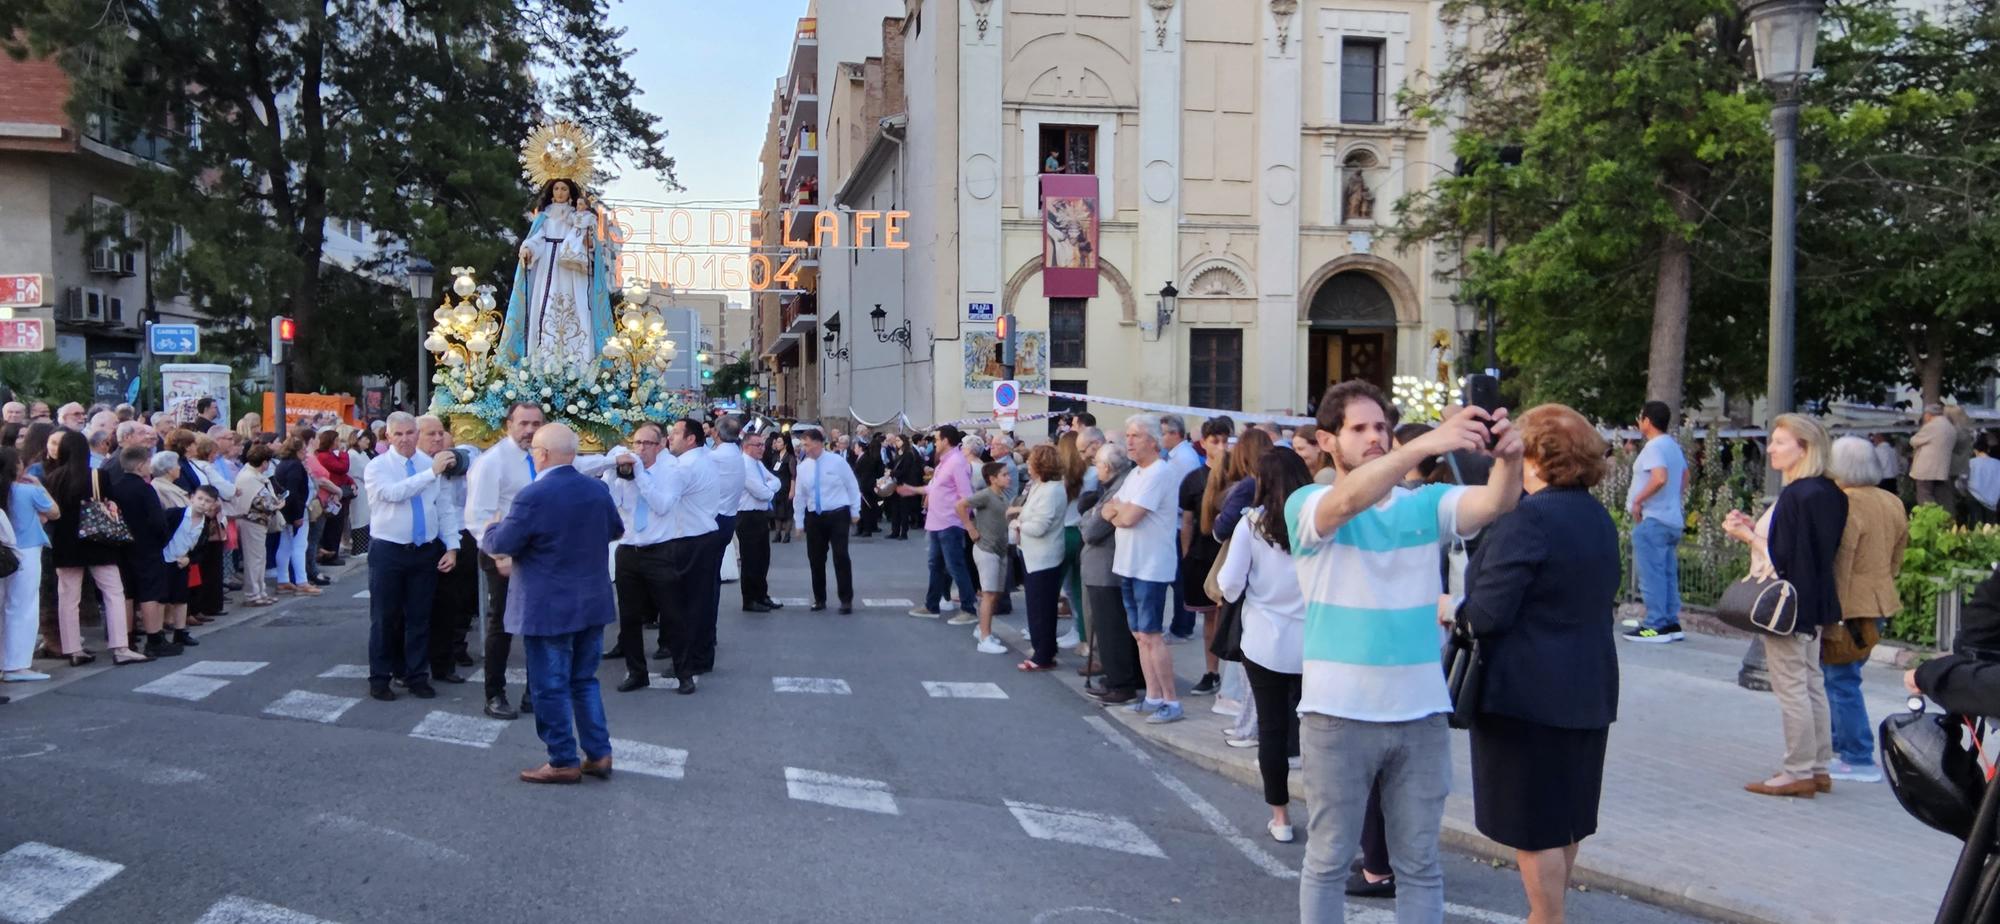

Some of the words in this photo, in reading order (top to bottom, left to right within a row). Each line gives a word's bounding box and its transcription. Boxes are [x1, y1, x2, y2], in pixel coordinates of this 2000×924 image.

[709, 209, 763, 247] DE
[784, 210, 838, 248] LA
[856, 211, 910, 249] FE
[703, 253, 798, 290] 1604
